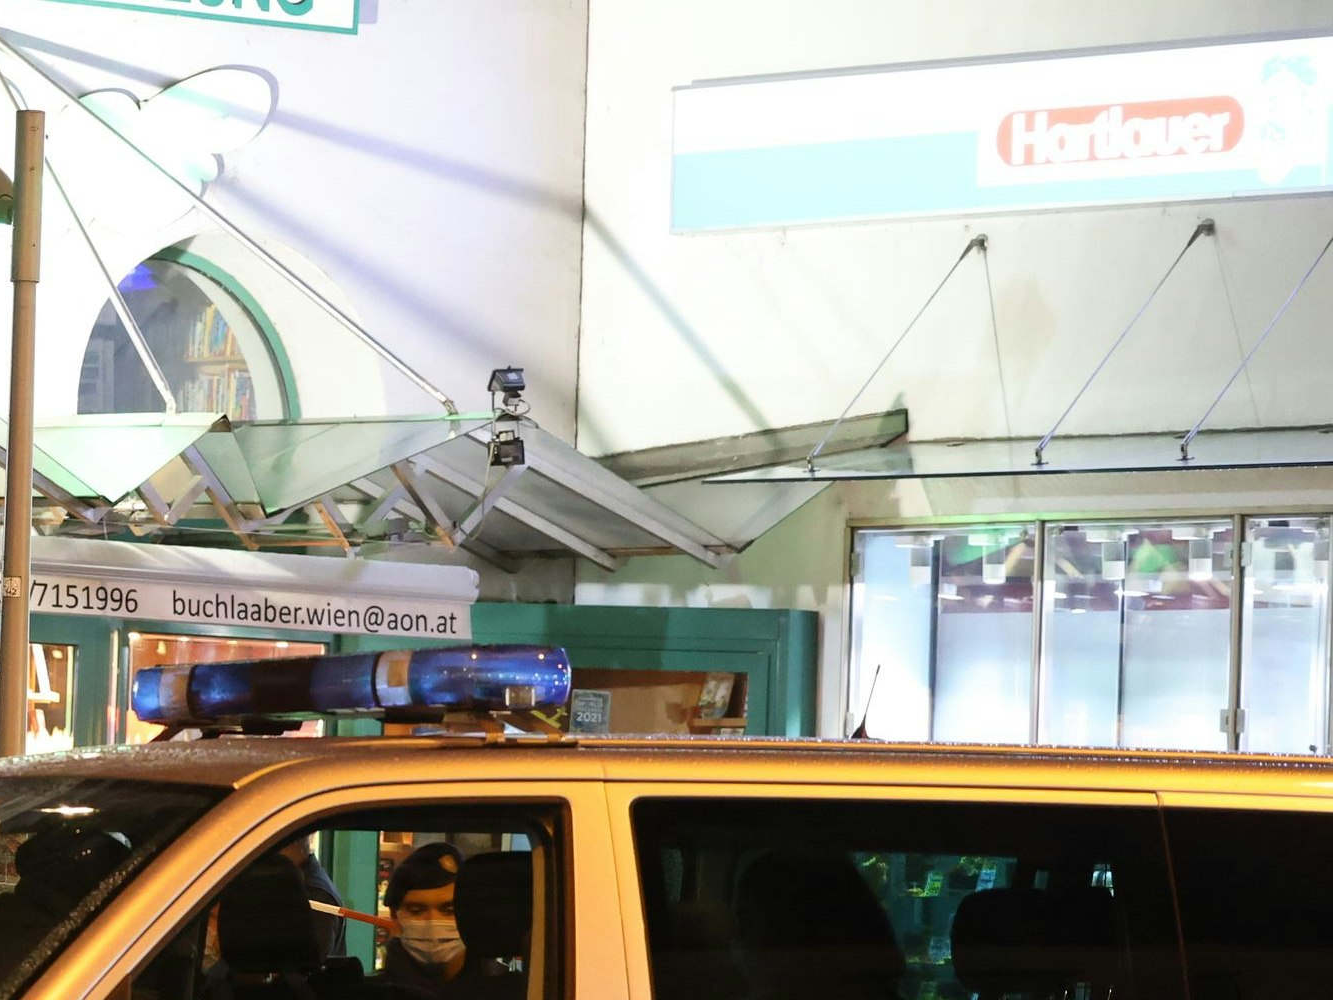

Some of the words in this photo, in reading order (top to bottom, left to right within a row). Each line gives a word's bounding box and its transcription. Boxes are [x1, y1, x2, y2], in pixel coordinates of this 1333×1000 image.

[1011, 103, 1231, 165] Hartlauer
[172, 590, 458, 635] buchlaaber.wien@aon.at
[576, 711, 602, 723] 2021
